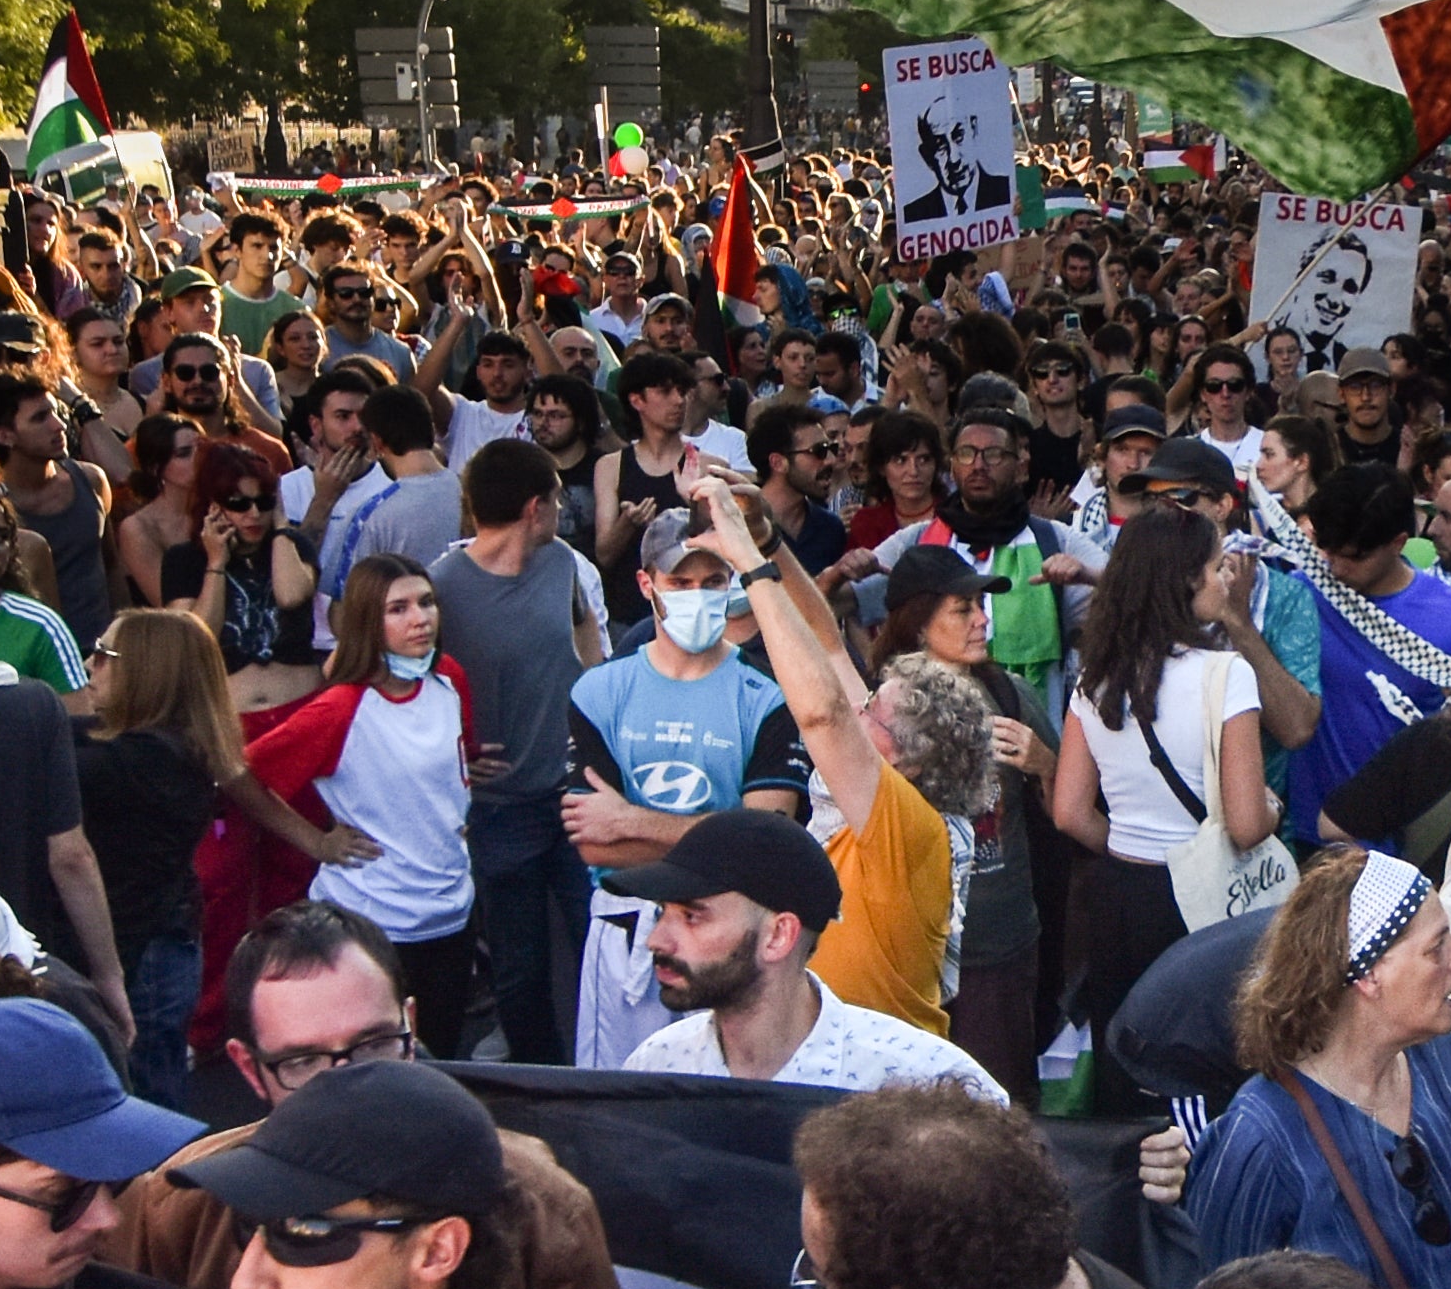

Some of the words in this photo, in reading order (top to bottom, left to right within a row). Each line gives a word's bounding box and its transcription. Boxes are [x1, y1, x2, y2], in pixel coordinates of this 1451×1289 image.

[896, 58, 921, 82] SE
[928, 48, 996, 79] BUSCA
[1275, 196, 1307, 221] SE
[1315, 199, 1405, 232] BUSCA
[900, 215, 1015, 259] GENOCIDA
